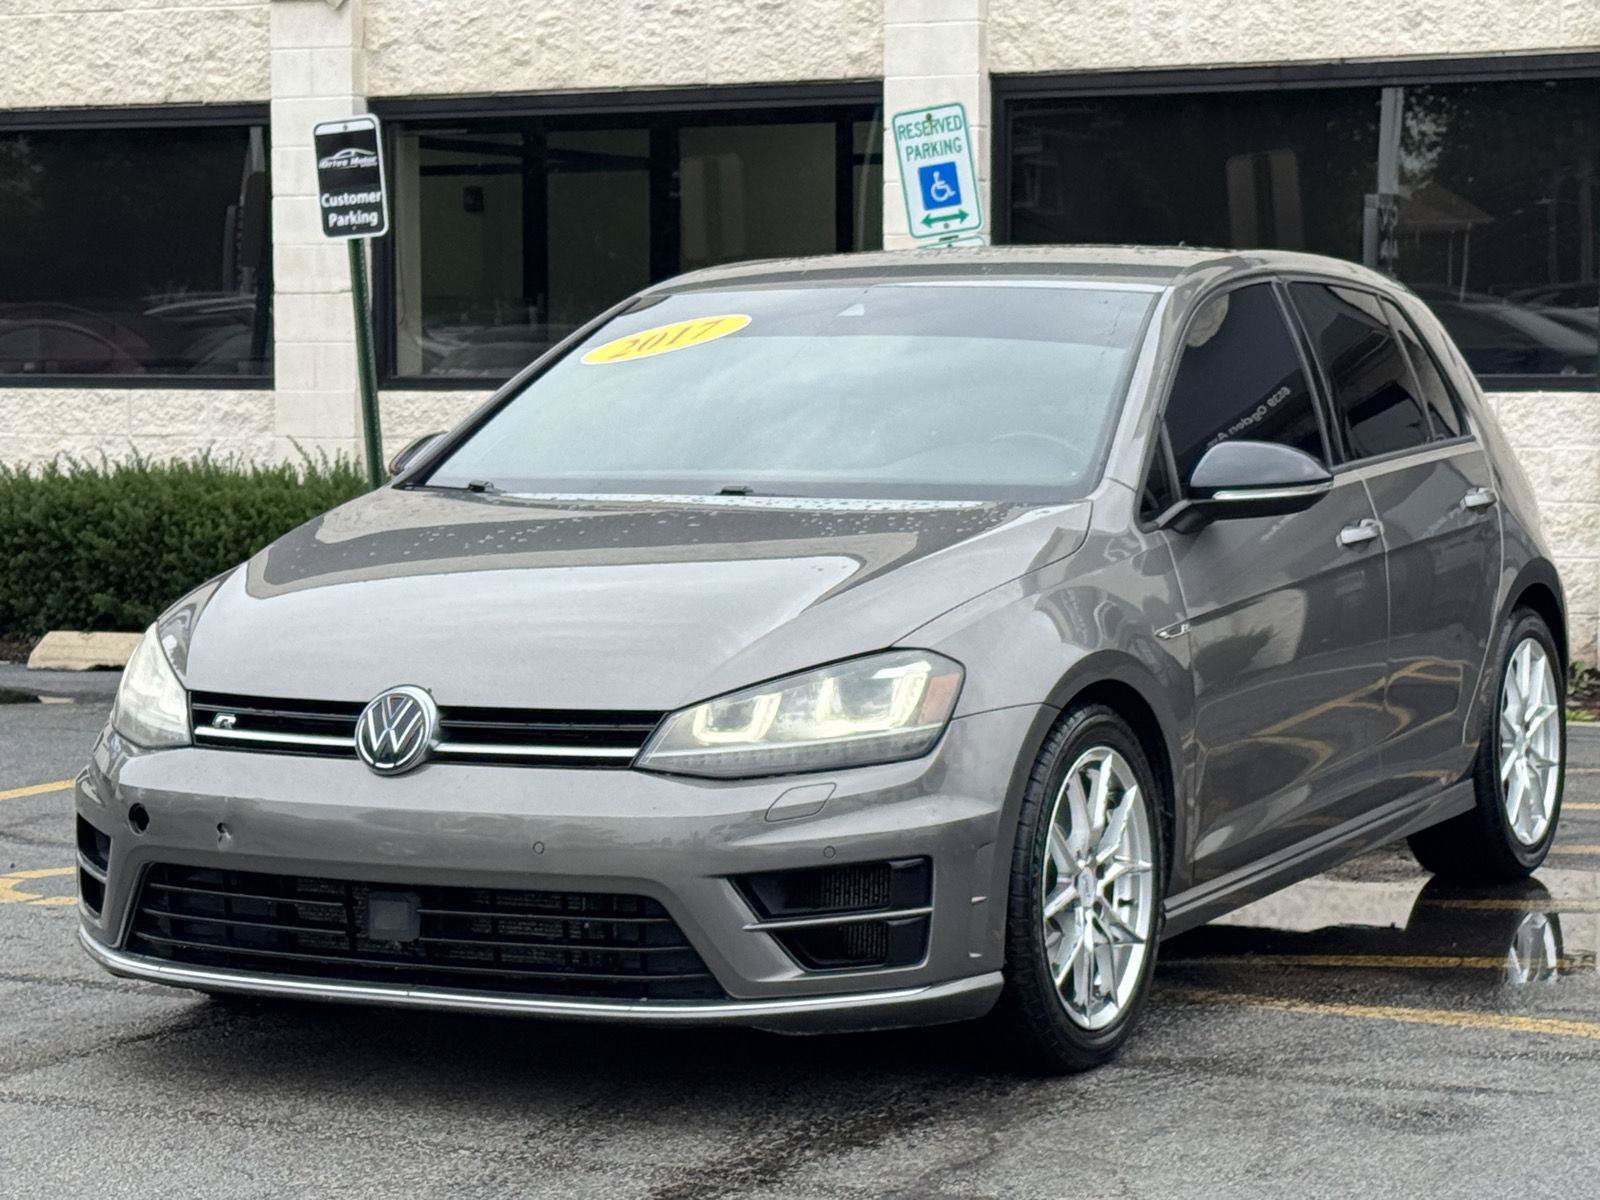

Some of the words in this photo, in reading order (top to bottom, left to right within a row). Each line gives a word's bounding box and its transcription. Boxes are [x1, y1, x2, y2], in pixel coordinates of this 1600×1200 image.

[897, 115, 962, 140] RESERVED
[905, 137, 962, 161] PARKING
[321, 191, 381, 207] Customer
[328, 210, 379, 227] Parking
[608, 319, 725, 360] 2017
